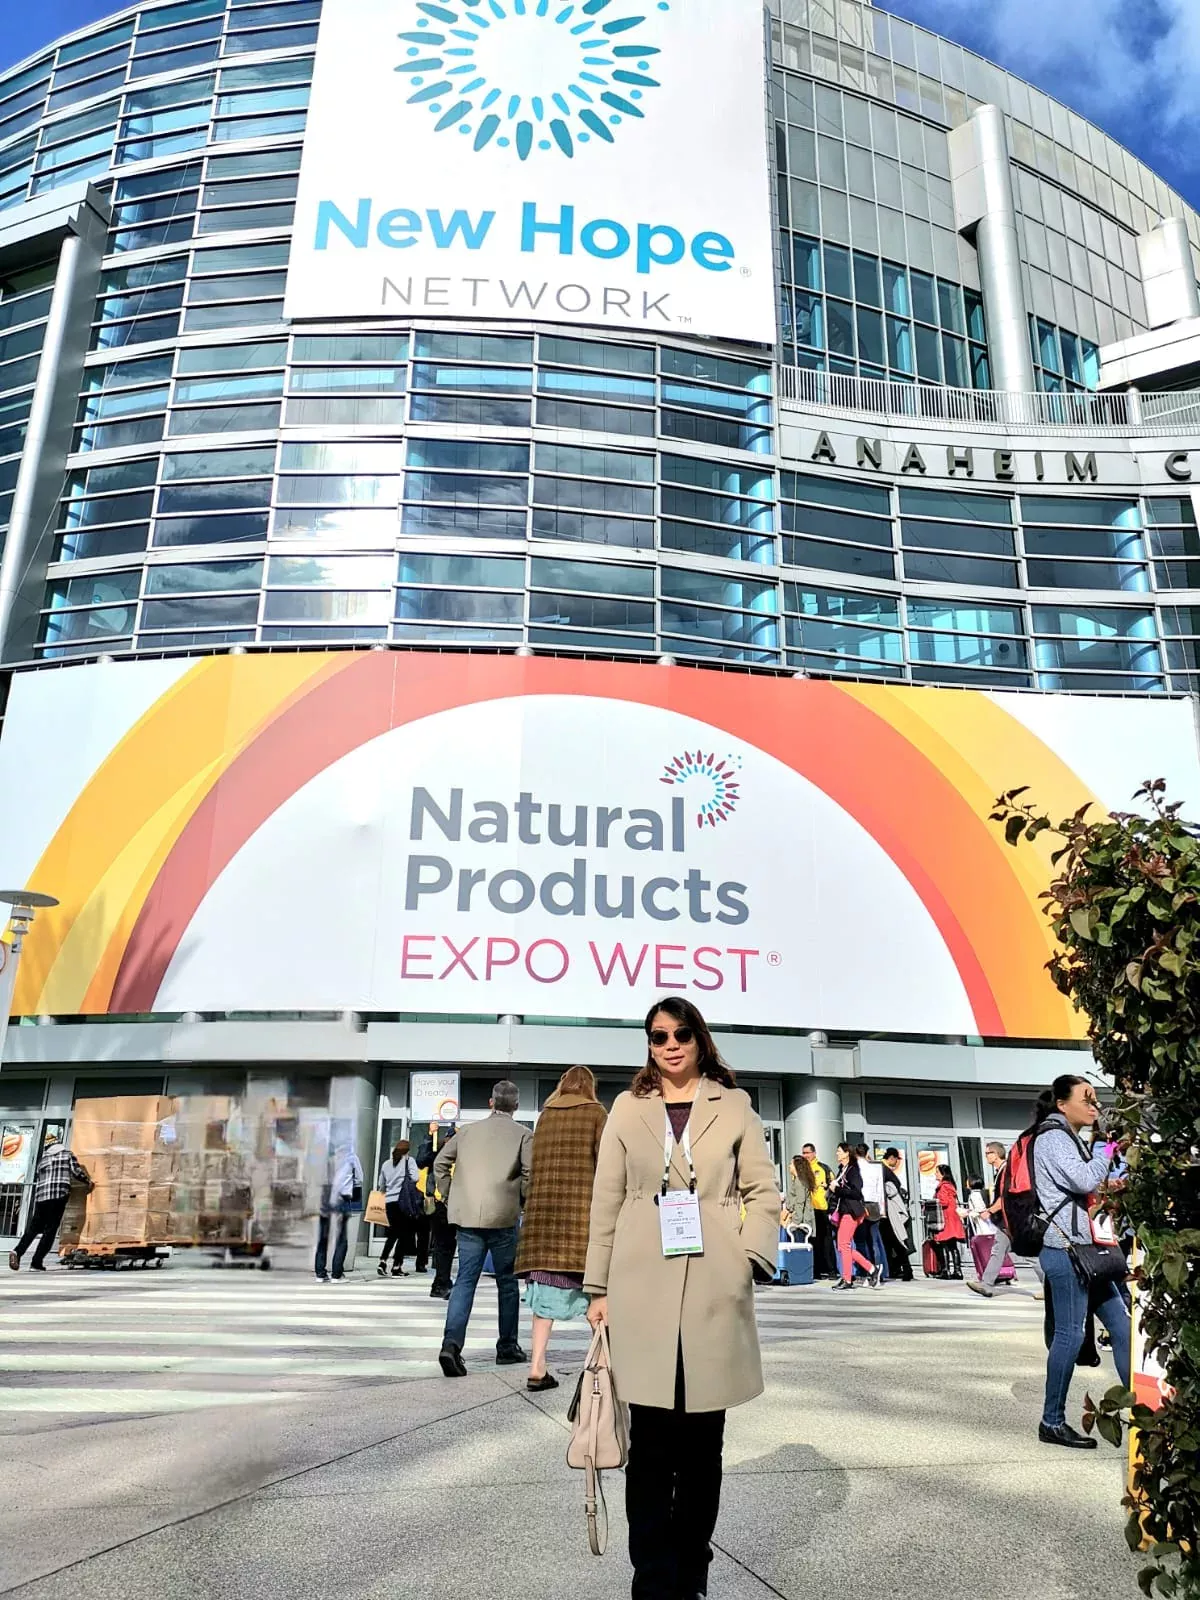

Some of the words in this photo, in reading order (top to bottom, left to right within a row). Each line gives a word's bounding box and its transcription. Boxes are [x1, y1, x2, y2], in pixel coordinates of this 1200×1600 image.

[313, 198, 496, 250] New
[520, 201, 735, 275] Hope
[381, 276, 671, 322] NETWORK
[811, 430, 1099, 482] ANAHEIM
[1164, 451, 1192, 481] C
[409, 786, 685, 852] Natural
[404, 854, 750, 926] Products
[400, 935, 570, 984] EXPO
[588, 941, 760, 992] WEST
